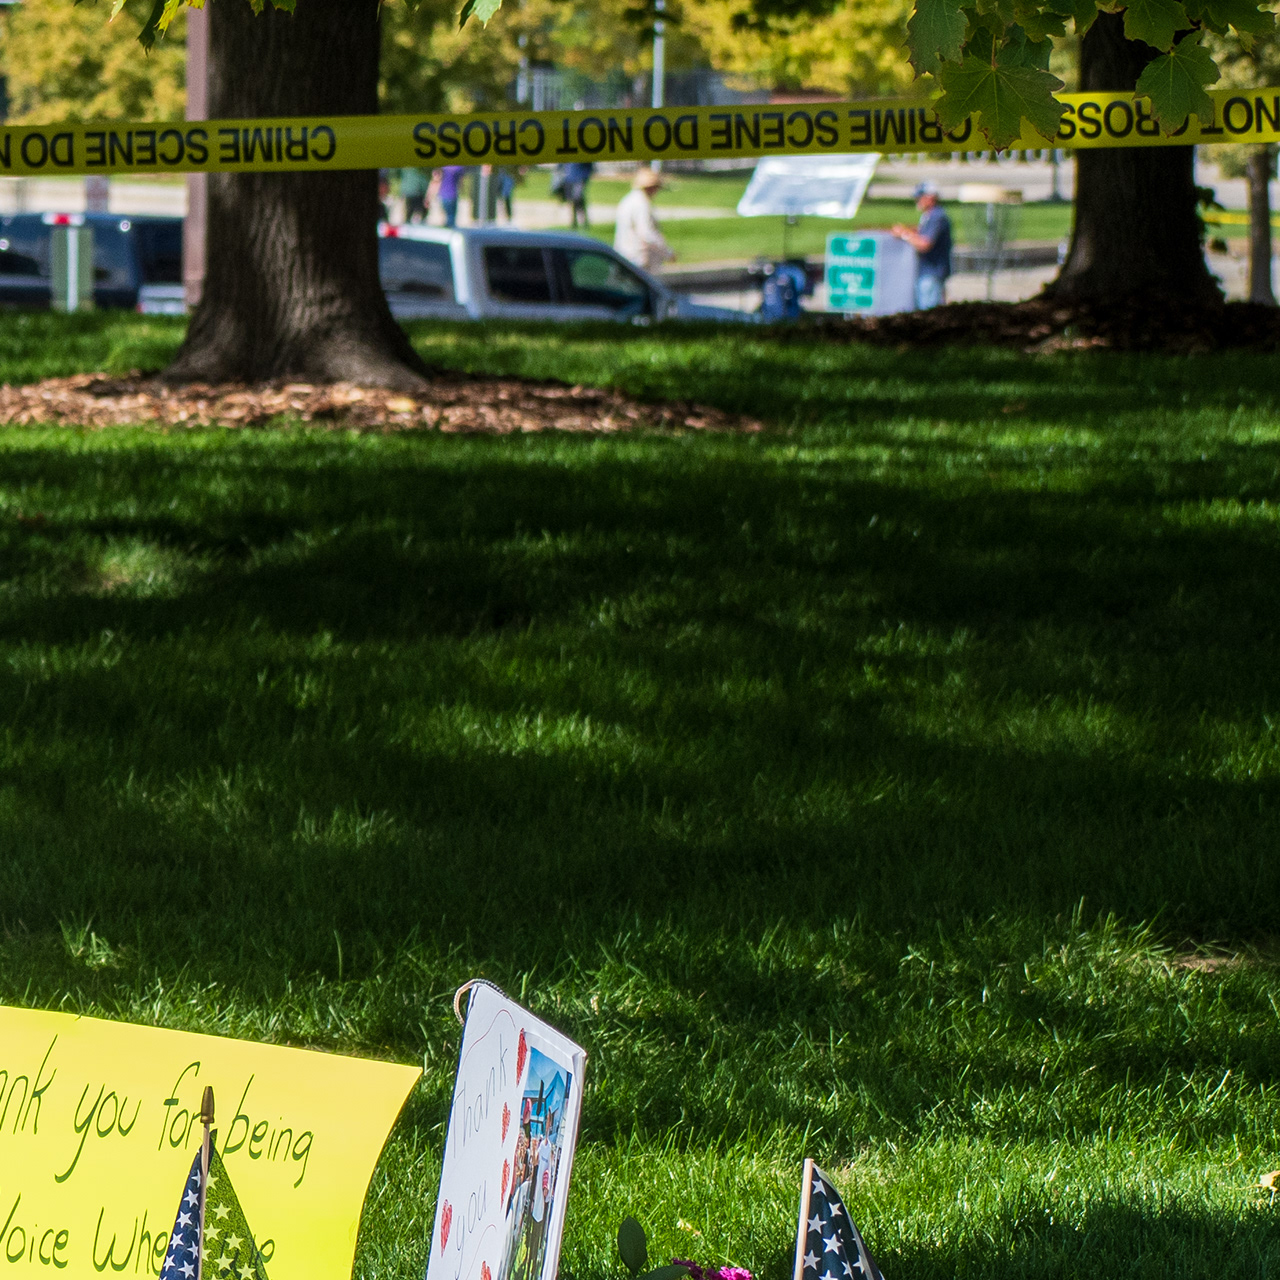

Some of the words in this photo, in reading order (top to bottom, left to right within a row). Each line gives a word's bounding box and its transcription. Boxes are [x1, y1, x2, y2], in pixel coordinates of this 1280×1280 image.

[86, 129, 209, 166] SCENE
[219, 125, 336, 162] CRIME
[413, 118, 545, 159] CROSS
[556, 117, 633, 155] NOT
[643, 115, 698, 153] DO
[710, 111, 839, 149] SCENE
[20, 132, 74, 167] DO
[452, 1032, 508, 1160] Thank
[54, 1085, 142, 1183] you
[223, 1074, 315, 1188] being
[91, 1207, 170, 1276] Whe
